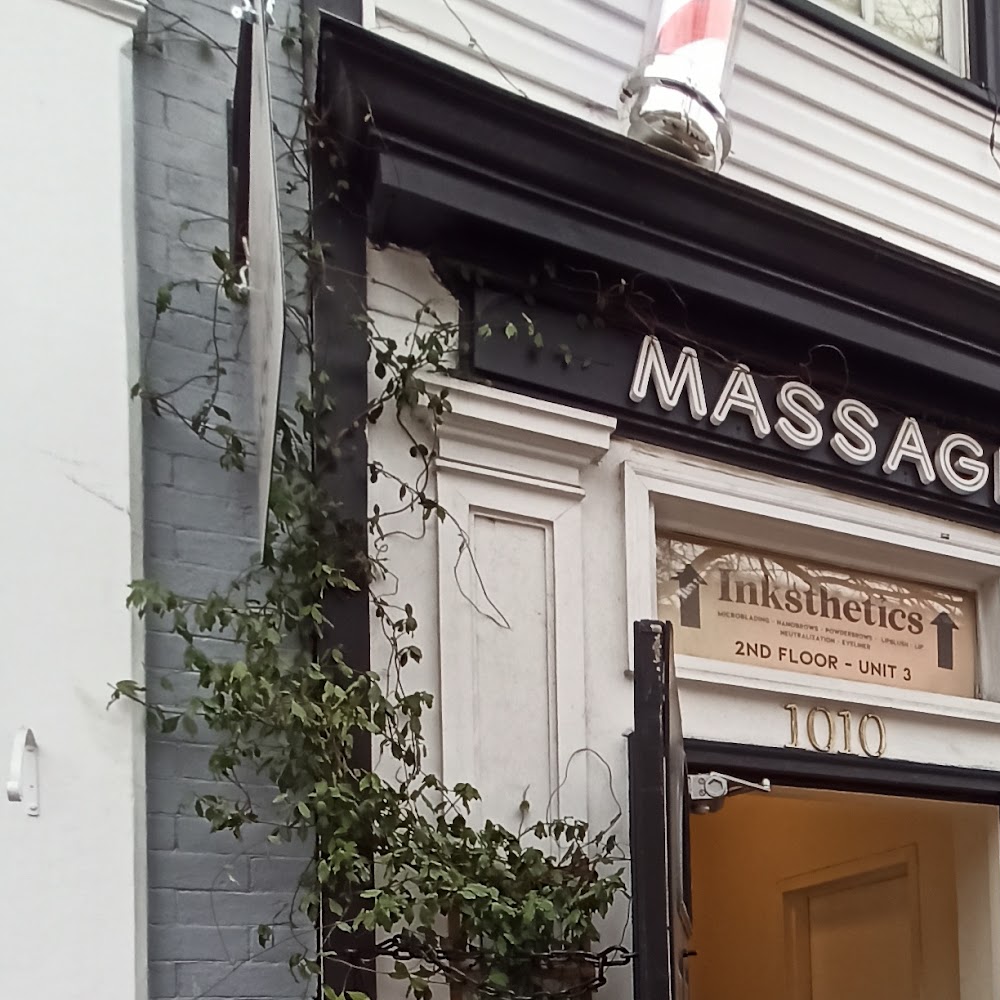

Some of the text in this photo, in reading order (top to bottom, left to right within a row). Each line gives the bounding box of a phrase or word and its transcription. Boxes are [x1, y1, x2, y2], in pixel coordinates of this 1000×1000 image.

[718, 568, 924, 634] Inksthetics
[734, 640, 772, 659] 2ND
[778, 647, 838, 670] FLOOR
[859, 660, 897, 678] UNIT
[903, 667, 912, 681] 3
[784, 703, 887, 758] 1010
